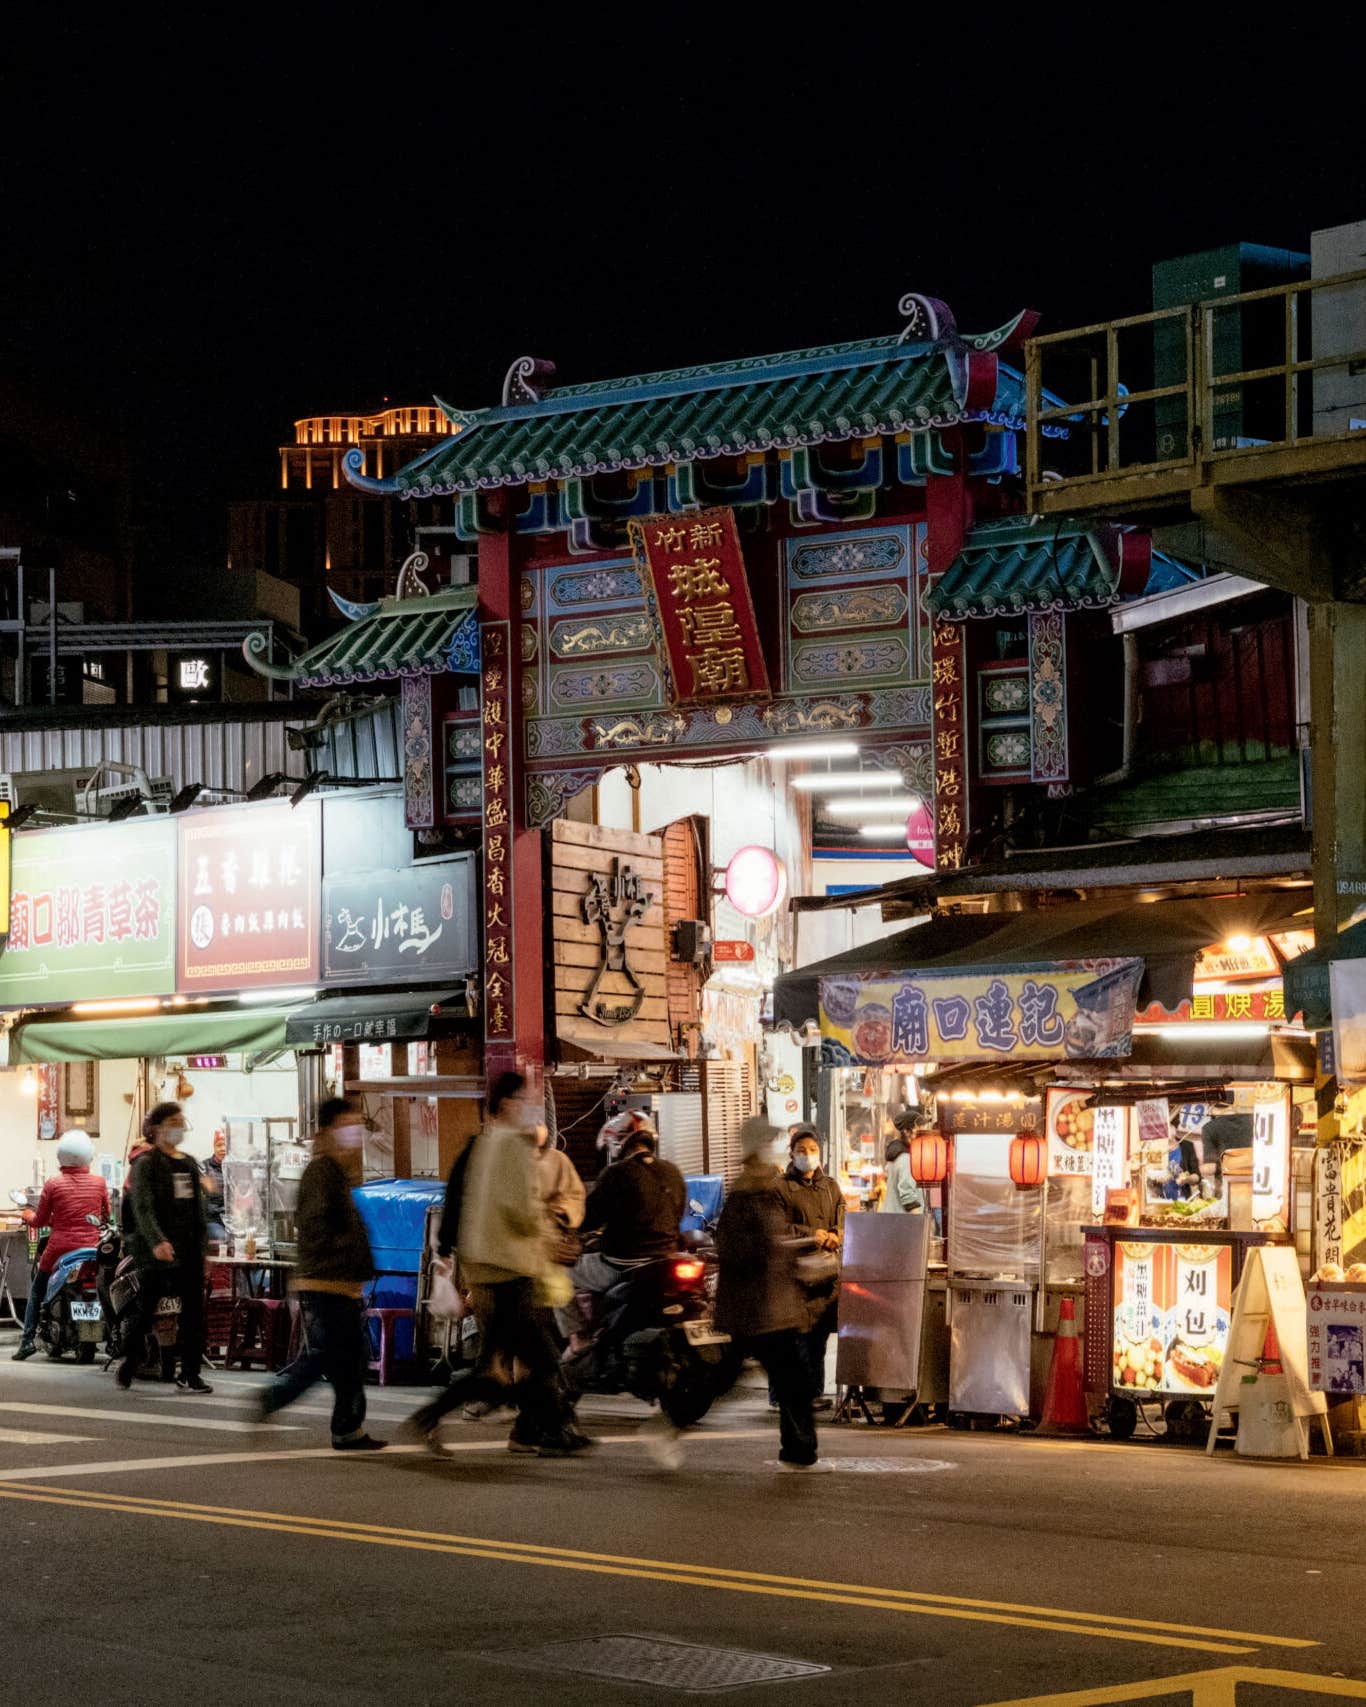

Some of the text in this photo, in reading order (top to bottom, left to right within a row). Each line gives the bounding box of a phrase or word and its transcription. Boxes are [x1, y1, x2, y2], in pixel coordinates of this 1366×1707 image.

[655, 522, 723, 552] 新竹
[667, 558, 748, 691] 城隍廟
[371, 896, 443, 955] 小木馬
[312, 1018, 397, 1041] 手作の一口就幸福
[892, 979, 1065, 1055] 廟口連記
[1185, 1269, 1207, 1334] 刈包
